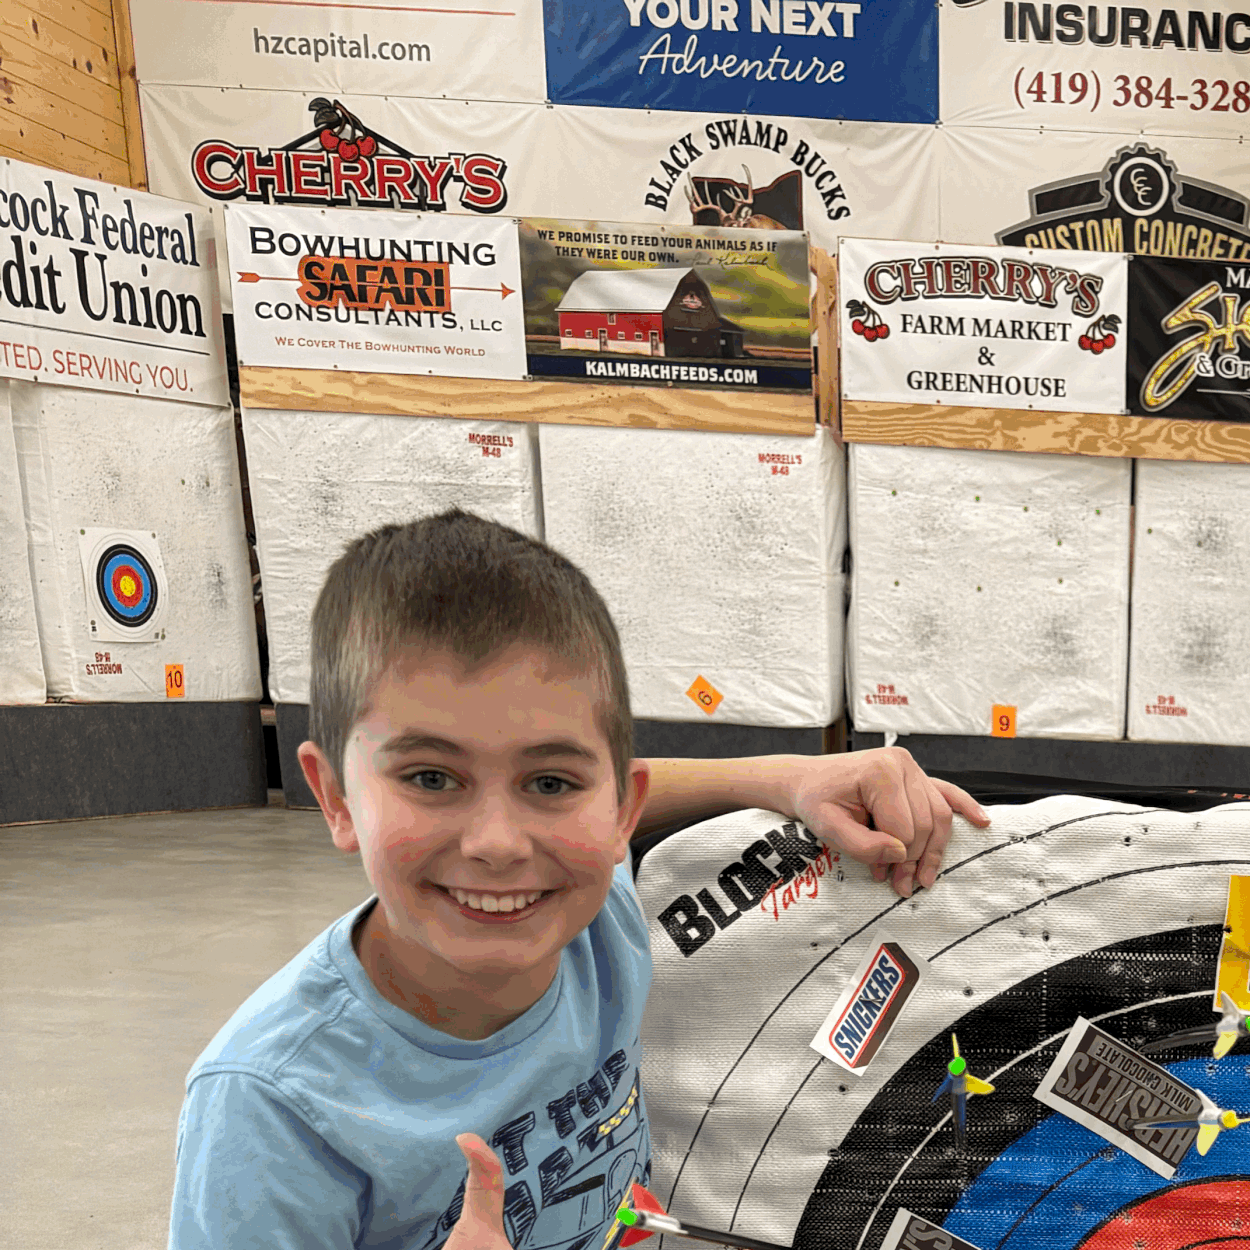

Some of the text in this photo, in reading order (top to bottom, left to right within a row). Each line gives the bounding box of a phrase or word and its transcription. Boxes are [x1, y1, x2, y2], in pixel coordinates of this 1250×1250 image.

[624, 0, 861, 38] YOUR NEXT
[253, 28, 431, 62] hzcapital.com
[639, 33, 846, 84] Adventure
[1014, 67, 1100, 112] (419)
[192, 138, 507, 212] CHERRY'S
[644, 119, 851, 221] BLACK SWAMP BUCKS
[73, 187, 200, 267] Federal
[249, 226, 497, 266] BOWHUNTING
[537, 229, 777, 252] WE PROMISE TO FEED YOUR ANIMALS AS IF
[555, 246, 585, 259] THEY
[586, 247, 618, 261] WERE
[620, 249, 646, 262] OUR
[648, 250, 680, 264] OWN.
[69, 248, 207, 337] Union
[303, 261, 446, 307] SAFARI
[864, 257, 1103, 318] CHERRY'S
[254, 302, 503, 332] CONSULTANTS, LLC
[900, 314, 1072, 342] FARM MARKET
[275, 336, 486, 357] WE COVER THE BOWHUNTING WORLD
[977, 346, 996, 366] &
[1194, 352, 1215, 378] &
[53, 350, 142, 384] SERVING
[146, 363, 193, 392] YOU.
[585, 361, 758, 384] KALMBACHFEEDS.COM
[906, 370, 1067, 397] GREENHOUSE
[468, 433, 514, 447] MORRELL'S
[168, 670, 183, 688] 10
[999, 714, 1011, 731] 9
[657, 821, 808, 958] BLOCK
[834, 955, 901, 1060] SNICKERS
[1099, 1042, 1194, 1112] MILK CHOCOLATE
